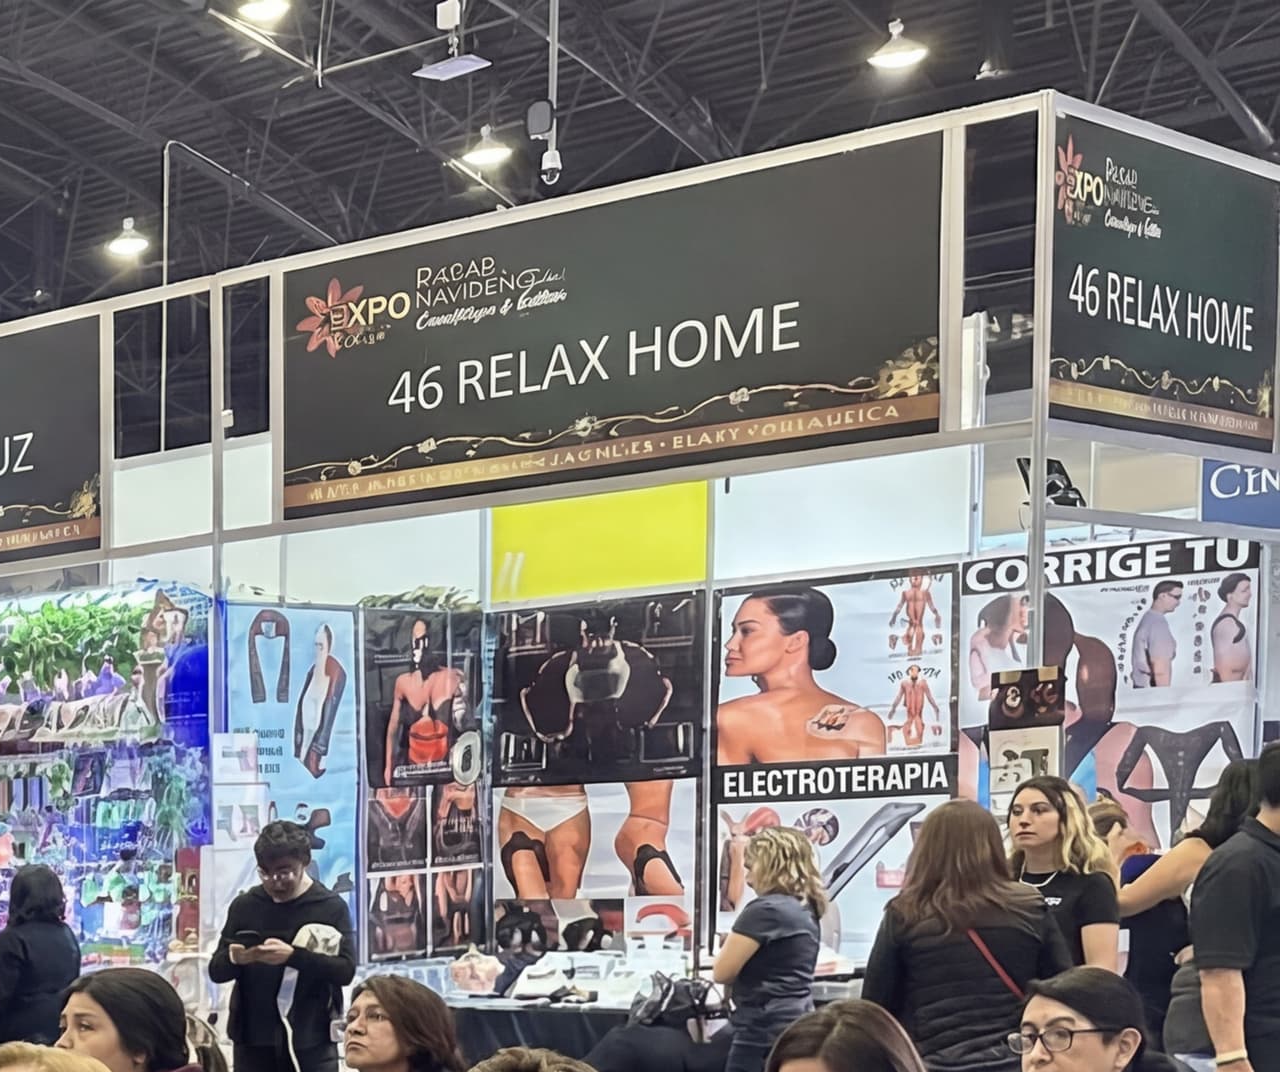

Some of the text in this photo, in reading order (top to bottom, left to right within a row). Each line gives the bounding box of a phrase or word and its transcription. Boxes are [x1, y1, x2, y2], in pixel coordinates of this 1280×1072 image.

[1068, 263, 1255, 352] 46 RELAX HOME
[387, 364, 444, 414] 46
[457, 334, 611, 405] RELAX
[628, 300, 801, 376] HOME
[965, 538, 1250, 592] CORRIGE TU
[723, 761, 949, 798] ELECTROTERAPIA
